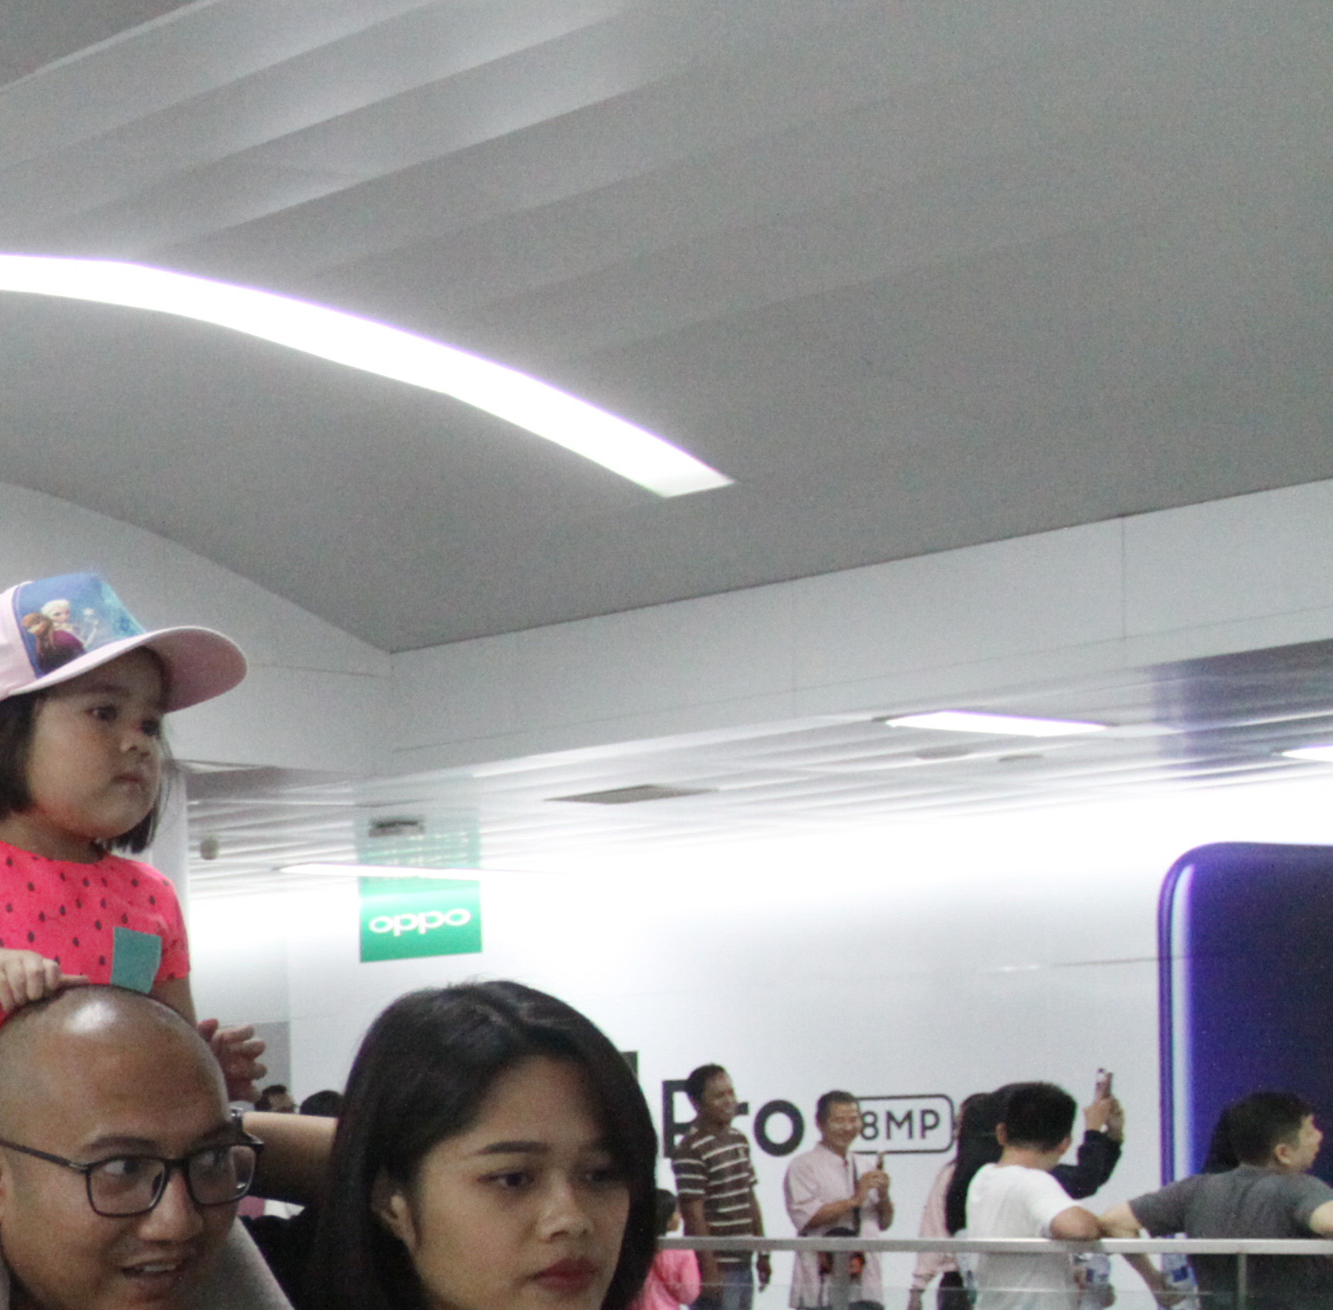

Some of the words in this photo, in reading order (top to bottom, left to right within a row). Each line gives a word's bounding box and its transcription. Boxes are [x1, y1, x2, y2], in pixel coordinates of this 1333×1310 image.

[368, 907, 472, 937] oppo
[662, 1078, 805, 1157] Po
[860, 1109, 940, 1142] 8MP
